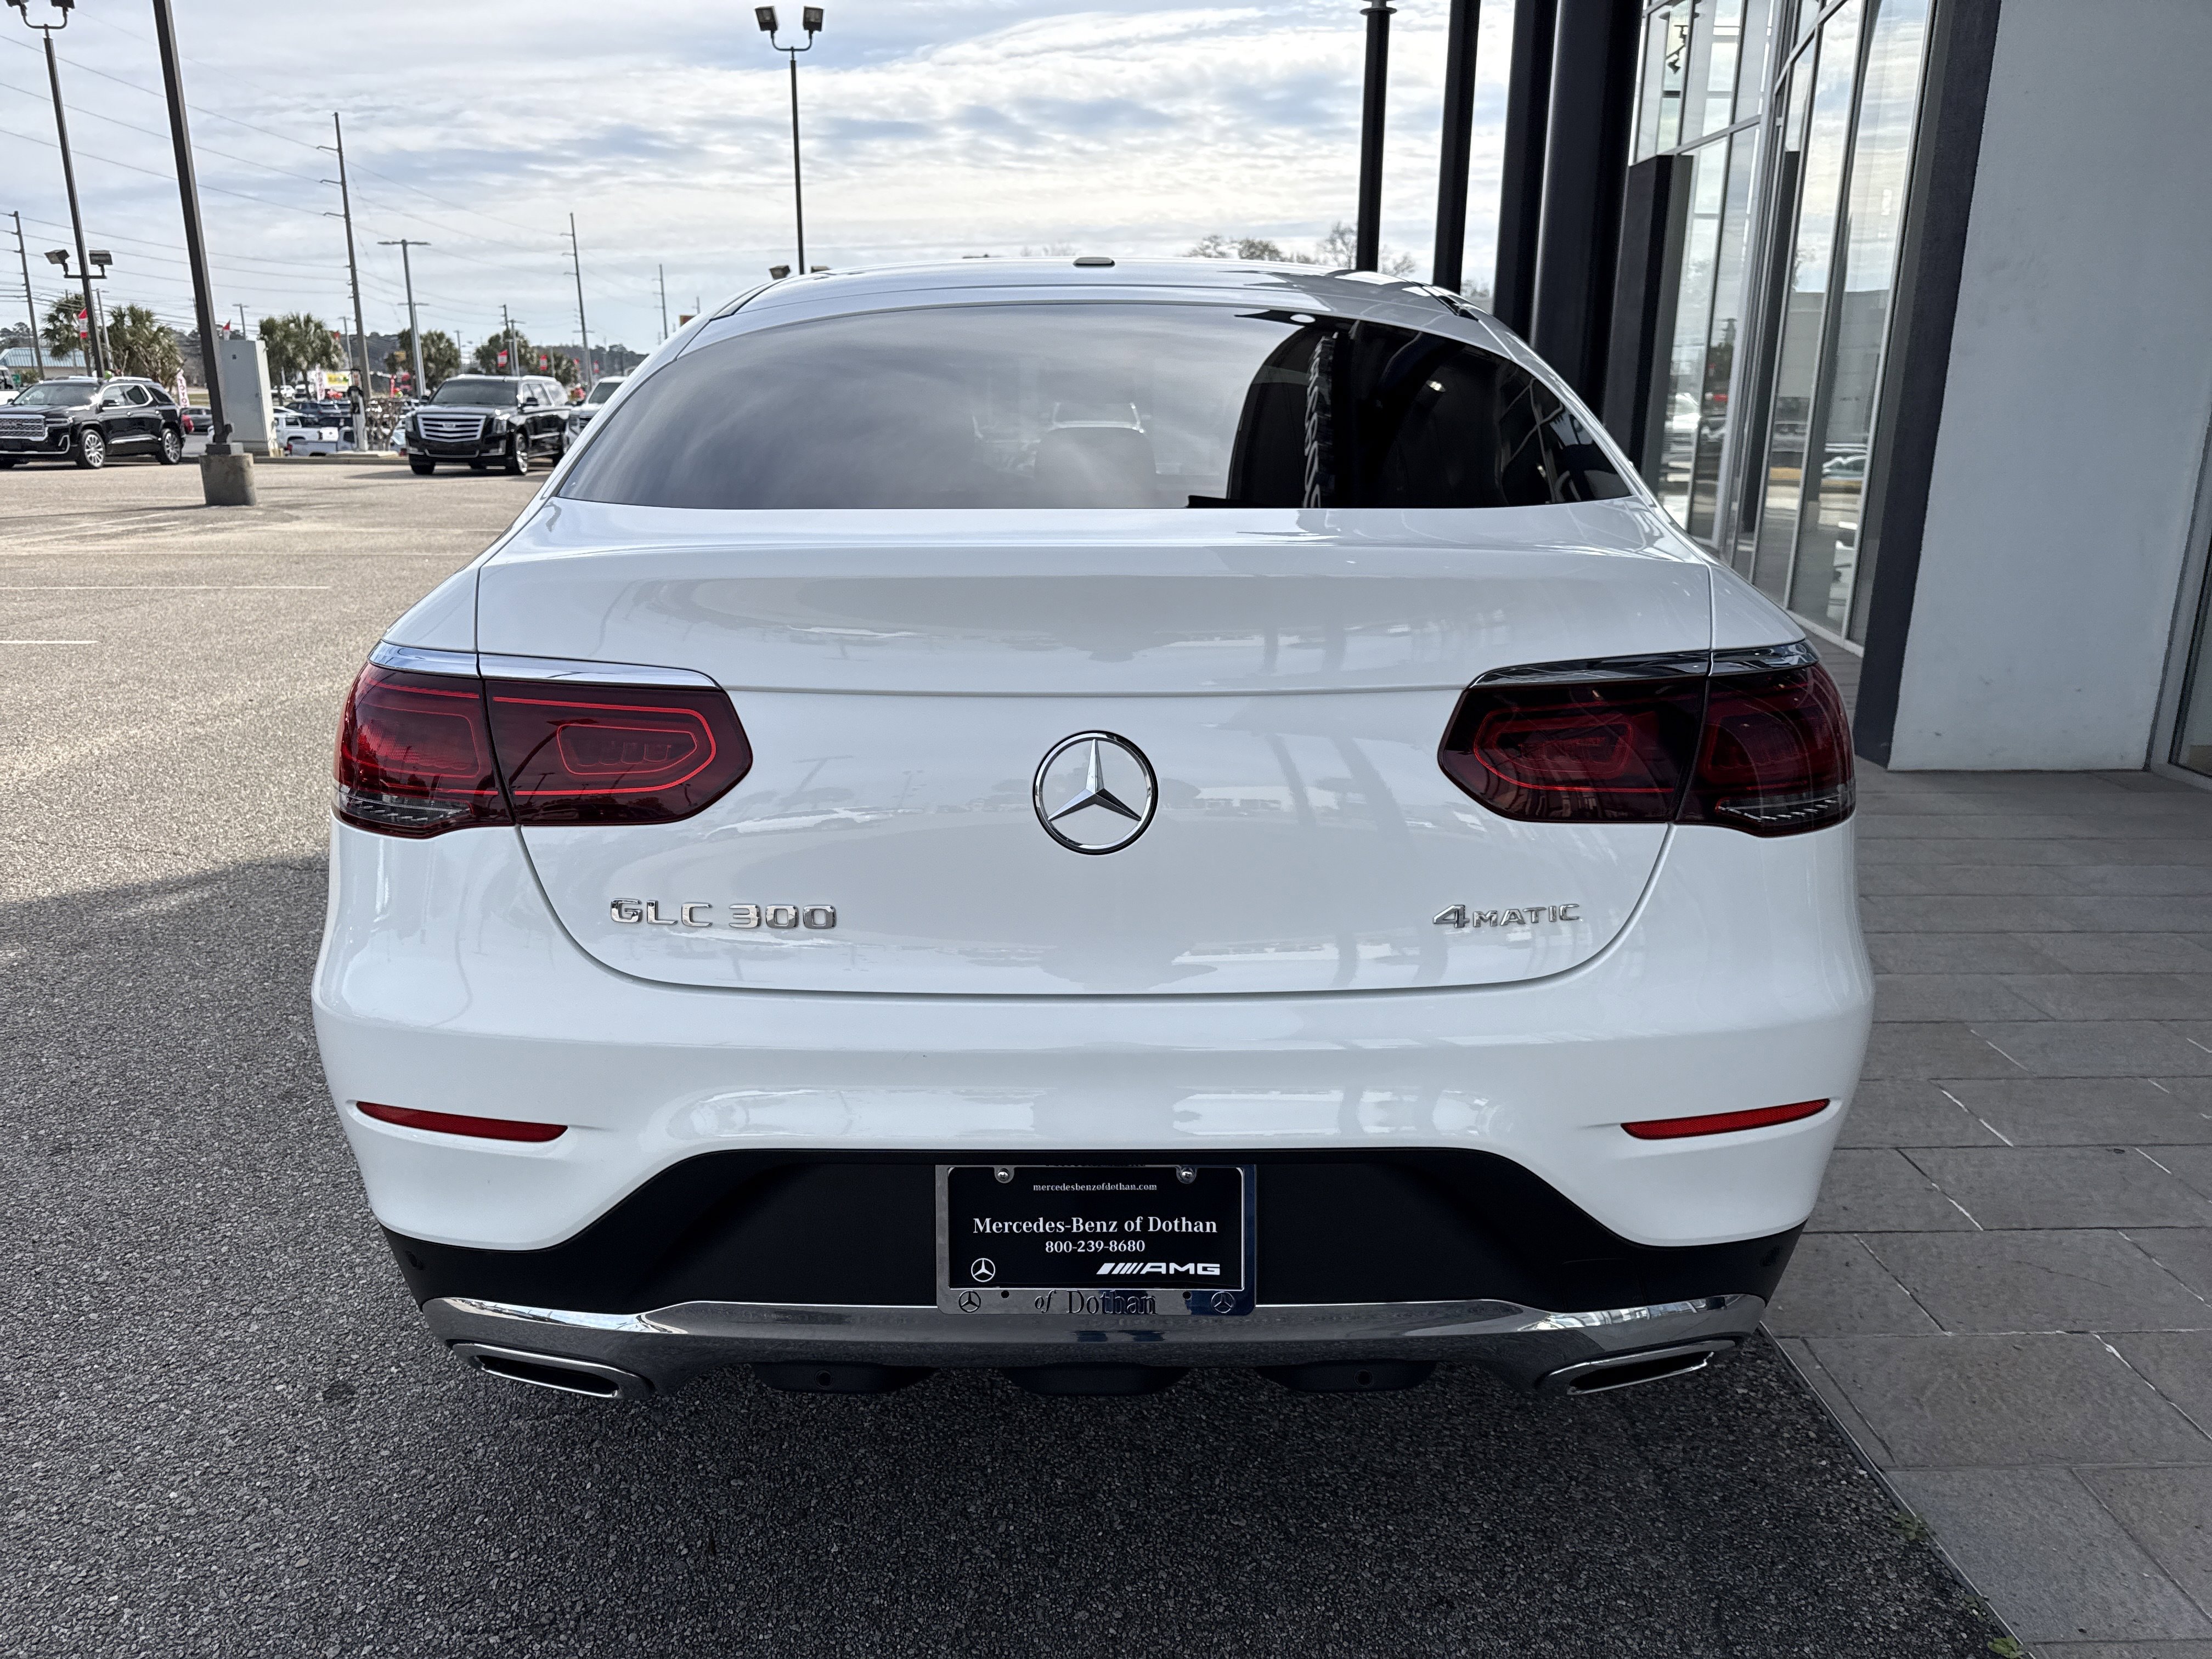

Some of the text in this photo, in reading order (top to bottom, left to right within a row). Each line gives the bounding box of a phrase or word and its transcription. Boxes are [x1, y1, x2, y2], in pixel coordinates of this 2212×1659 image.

[611, 898, 837, 929] GLC 300
[1432, 903, 1580, 928] 4MATIC
[1033, 1182, 1157, 1191] mercedesbenzofdothan.com
[973, 1216, 1218, 1234] Mercedes-Benz of Dothan
[1045, 1240, 1146, 1253] 800-239-8680
[1140, 1262, 1221, 1276] AMG
[1034, 1289, 1159, 1315] of Dothan
